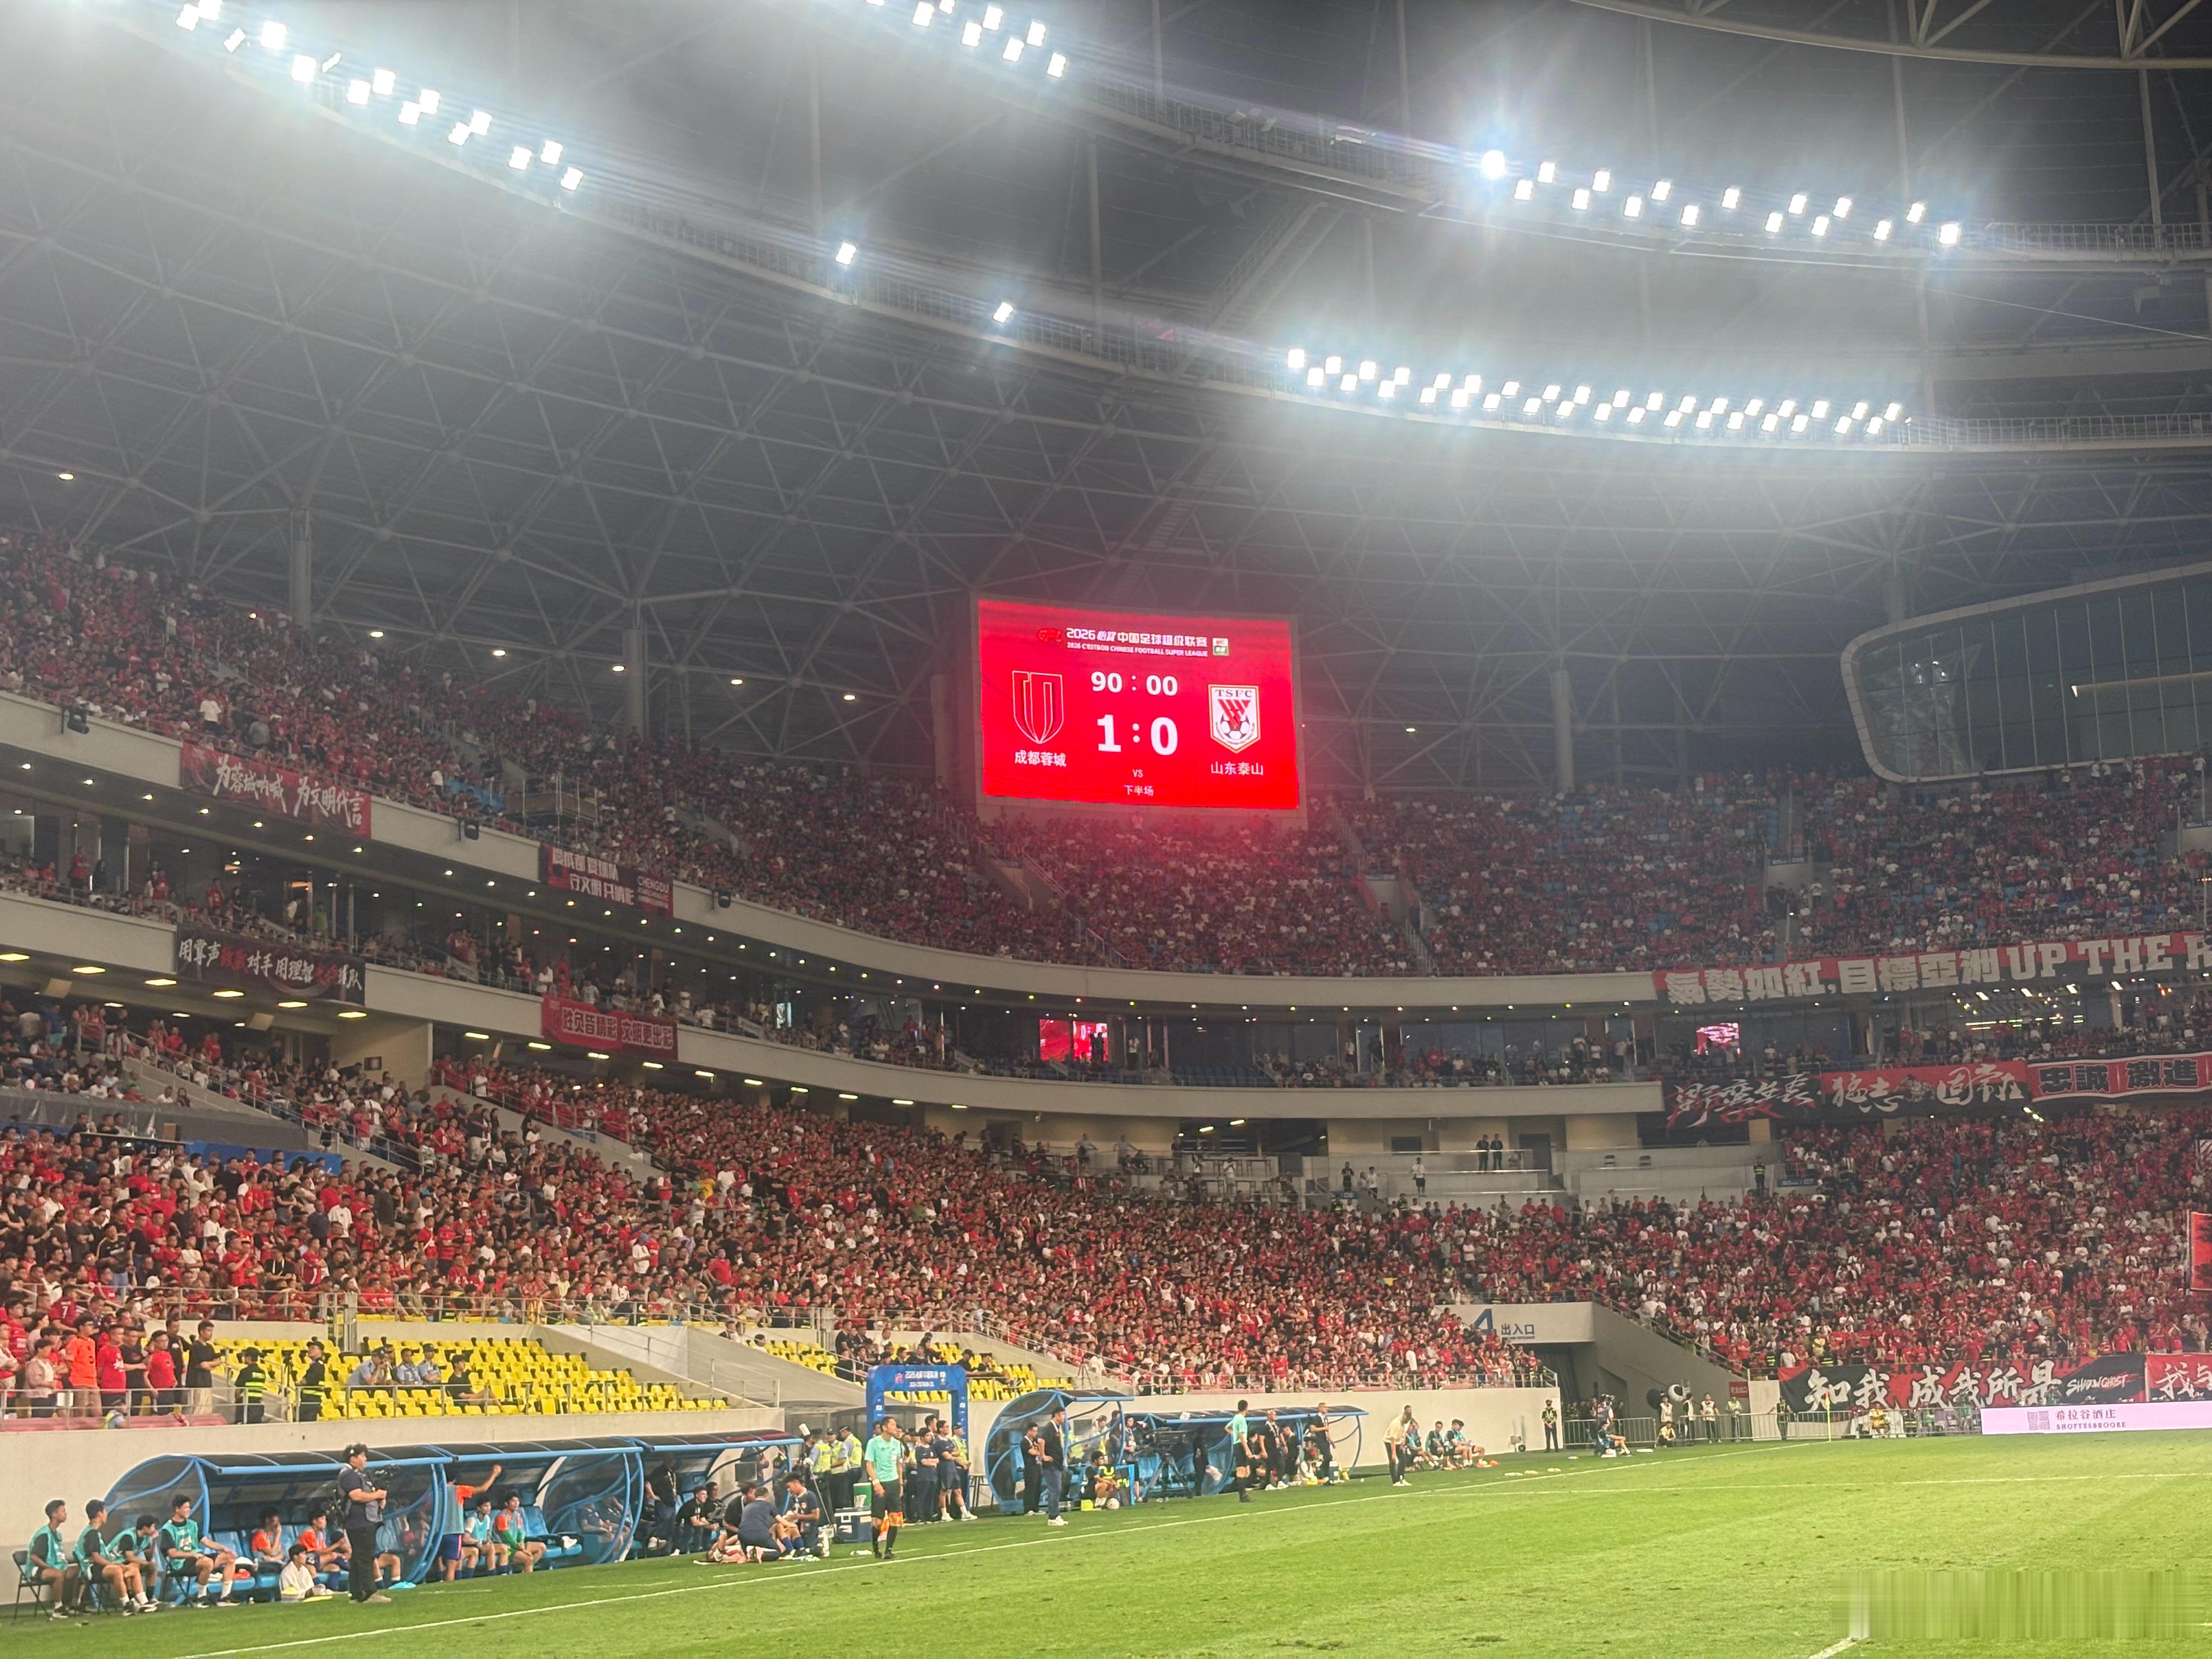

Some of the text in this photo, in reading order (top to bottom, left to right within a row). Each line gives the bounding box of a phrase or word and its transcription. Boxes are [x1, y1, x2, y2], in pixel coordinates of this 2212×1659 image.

[1135, 647, 1165, 655] FOOTBALL
[1014, 750, 1067, 768] 成都蓉城
[1132, 769, 1144, 777] VS
[1210, 760, 1264, 776] 山东泰山
[213, 753, 364, 828] 为蓉城呐喊 为文明代言
[1124, 785, 1154, 797] 下半场
[637, 876, 669, 894] CHENGDU
[2007, 943, 2067, 981] UP
[2078, 934, 2173, 975] THE
[561, 1006, 674, 1050] 胜负皆精彩 文明更出彩
[2038, 1064, 2111, 1094] 忠誠
[62, 1306, 69, 1318] 7
[1474, 1308, 1494, 1335] 4
[1501, 1323, 1535, 1335] 出入口
[2100, 1374, 2128, 1390] GHOST
[2056, 1408, 2116, 1420] 希拉谷酒庄
